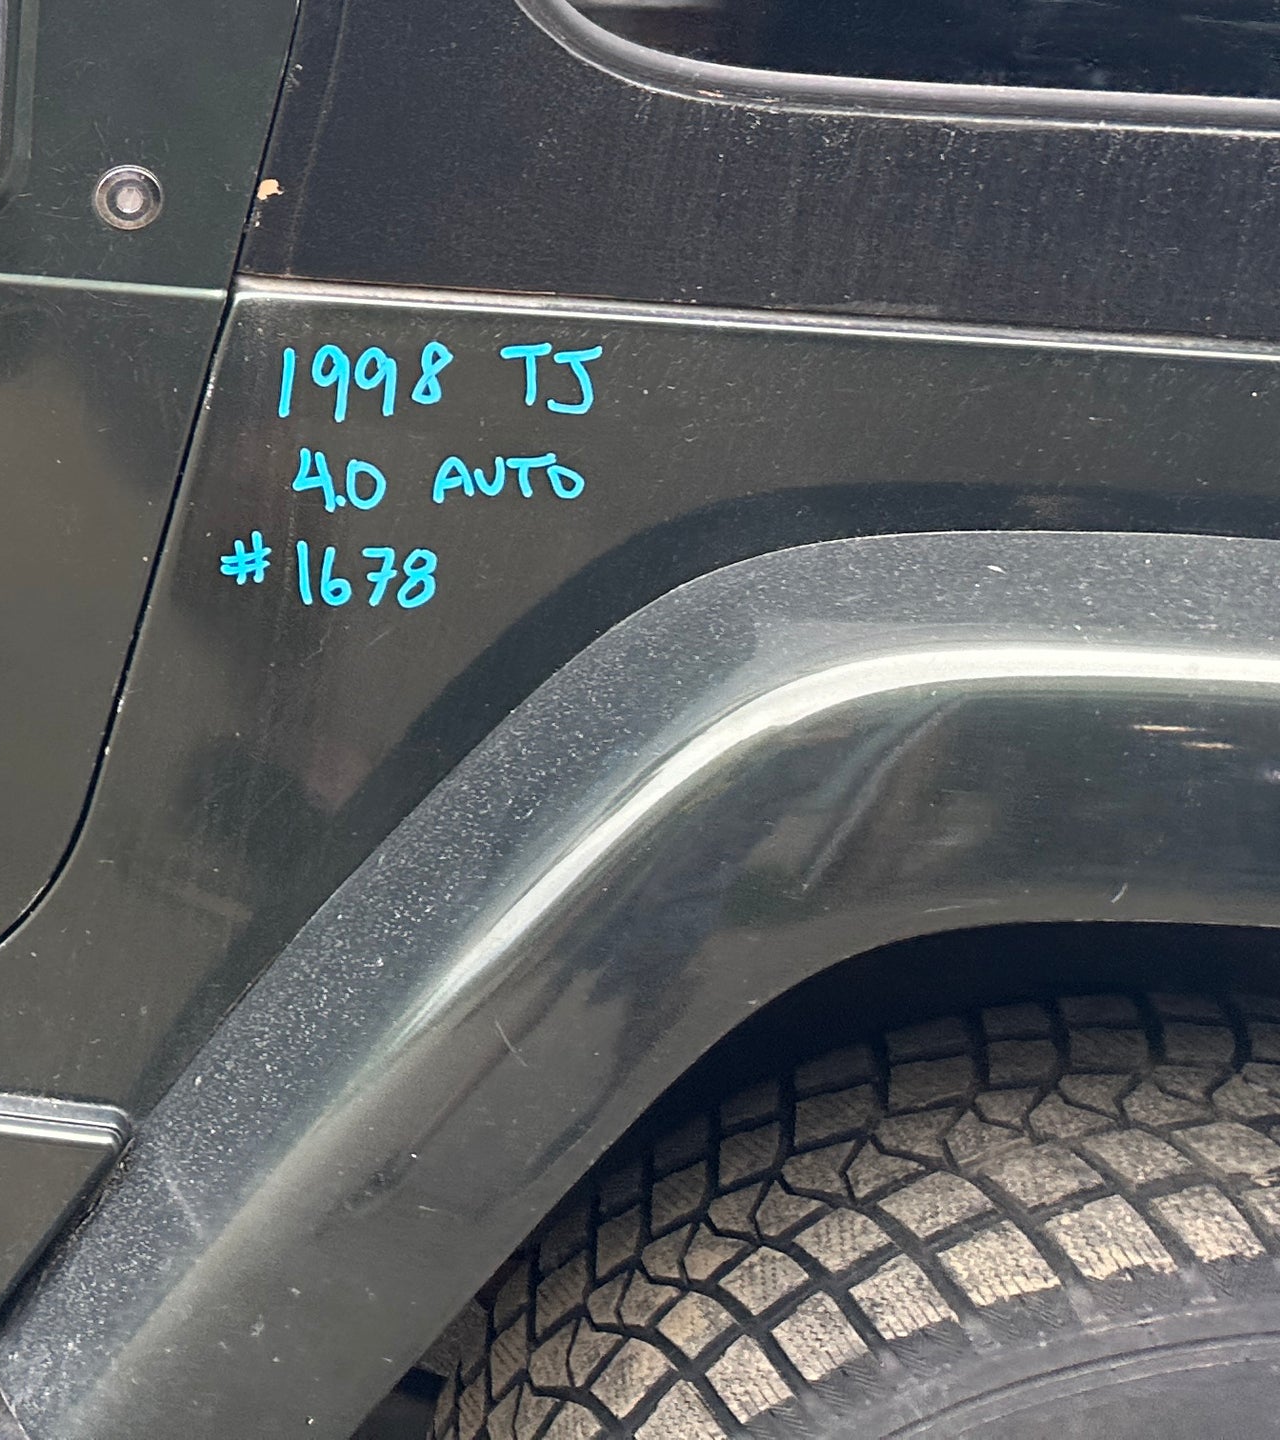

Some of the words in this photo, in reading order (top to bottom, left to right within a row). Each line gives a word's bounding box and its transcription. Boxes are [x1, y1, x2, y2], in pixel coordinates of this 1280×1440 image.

[278, 341, 454, 423] 1998
[500, 342, 603, 415] TJ
[292, 447, 387, 513] 4.0
[432, 453, 585, 504] AUTO
